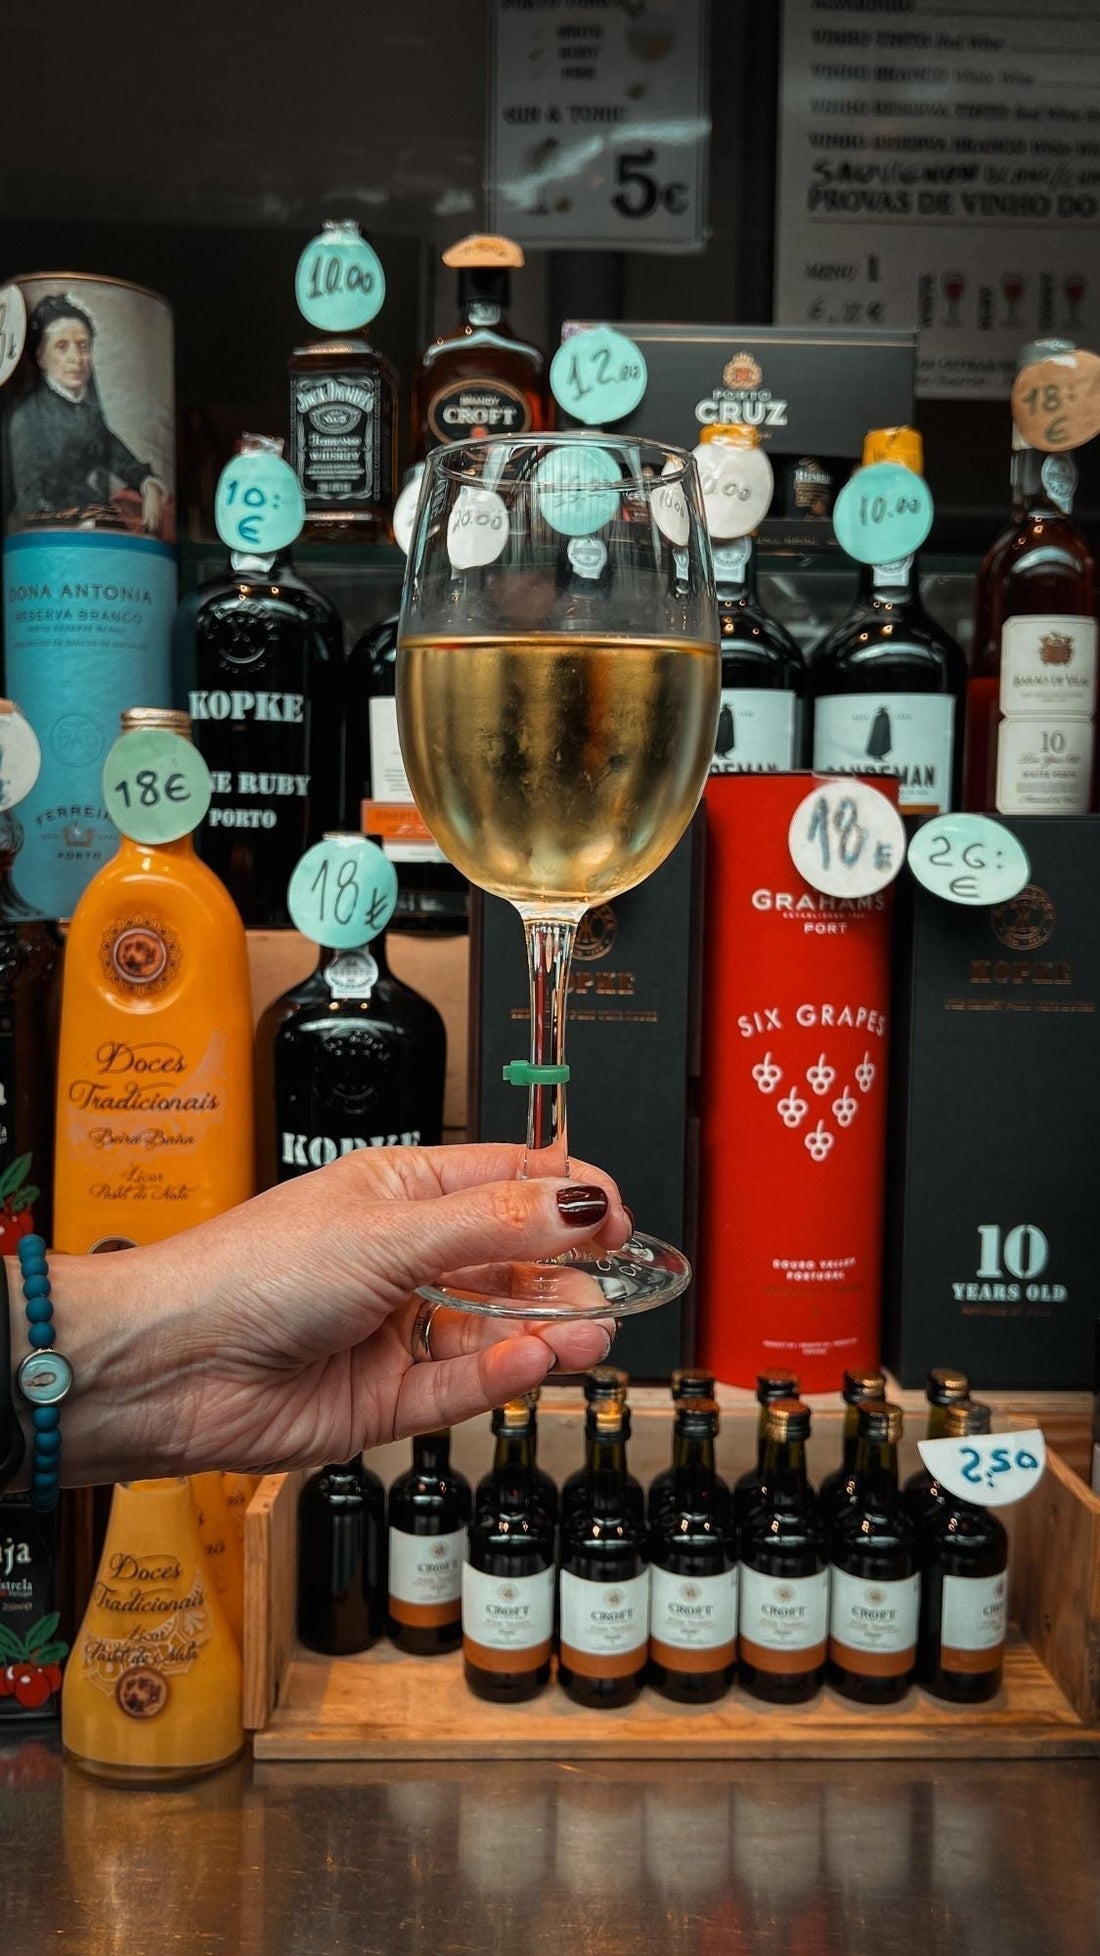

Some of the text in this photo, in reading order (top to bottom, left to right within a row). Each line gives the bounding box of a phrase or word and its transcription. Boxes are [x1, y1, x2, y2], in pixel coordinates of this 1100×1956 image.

[807, 186, 911, 214] PROVAS
[917, 191, 955, 216] DE
[960, 192, 1050, 218] VINHO
[307, 255, 373, 298] 10.00
[443, 404, 517, 425] CROFT
[695, 400, 788, 426] CRUZ
[238, 516, 265, 545] €
[60, 584, 153, 604] ANTONIA
[15, 608, 144, 625] RESERVA BRANCO
[188, 690, 304, 723] KOPKE
[1040, 729, 1066, 754] 10
[115, 770, 191, 808] 18€
[237, 772, 311, 797] RUBY
[209, 809, 278, 829] PORTO
[949, 875, 979, 898] €
[804, 921, 848, 935] PORT
[737, 1003, 888, 1038] SIX GRAPES
[96, 1041, 189, 1075] Doces
[68, 1079, 222, 1112] Tradicionais
[975, 1223, 1049, 1280] 10
[951, 1282, 1068, 1303] YEARS OLD
[109, 1552, 184, 1582] Doces
[96, 1580, 206, 1613] Tradicionais
